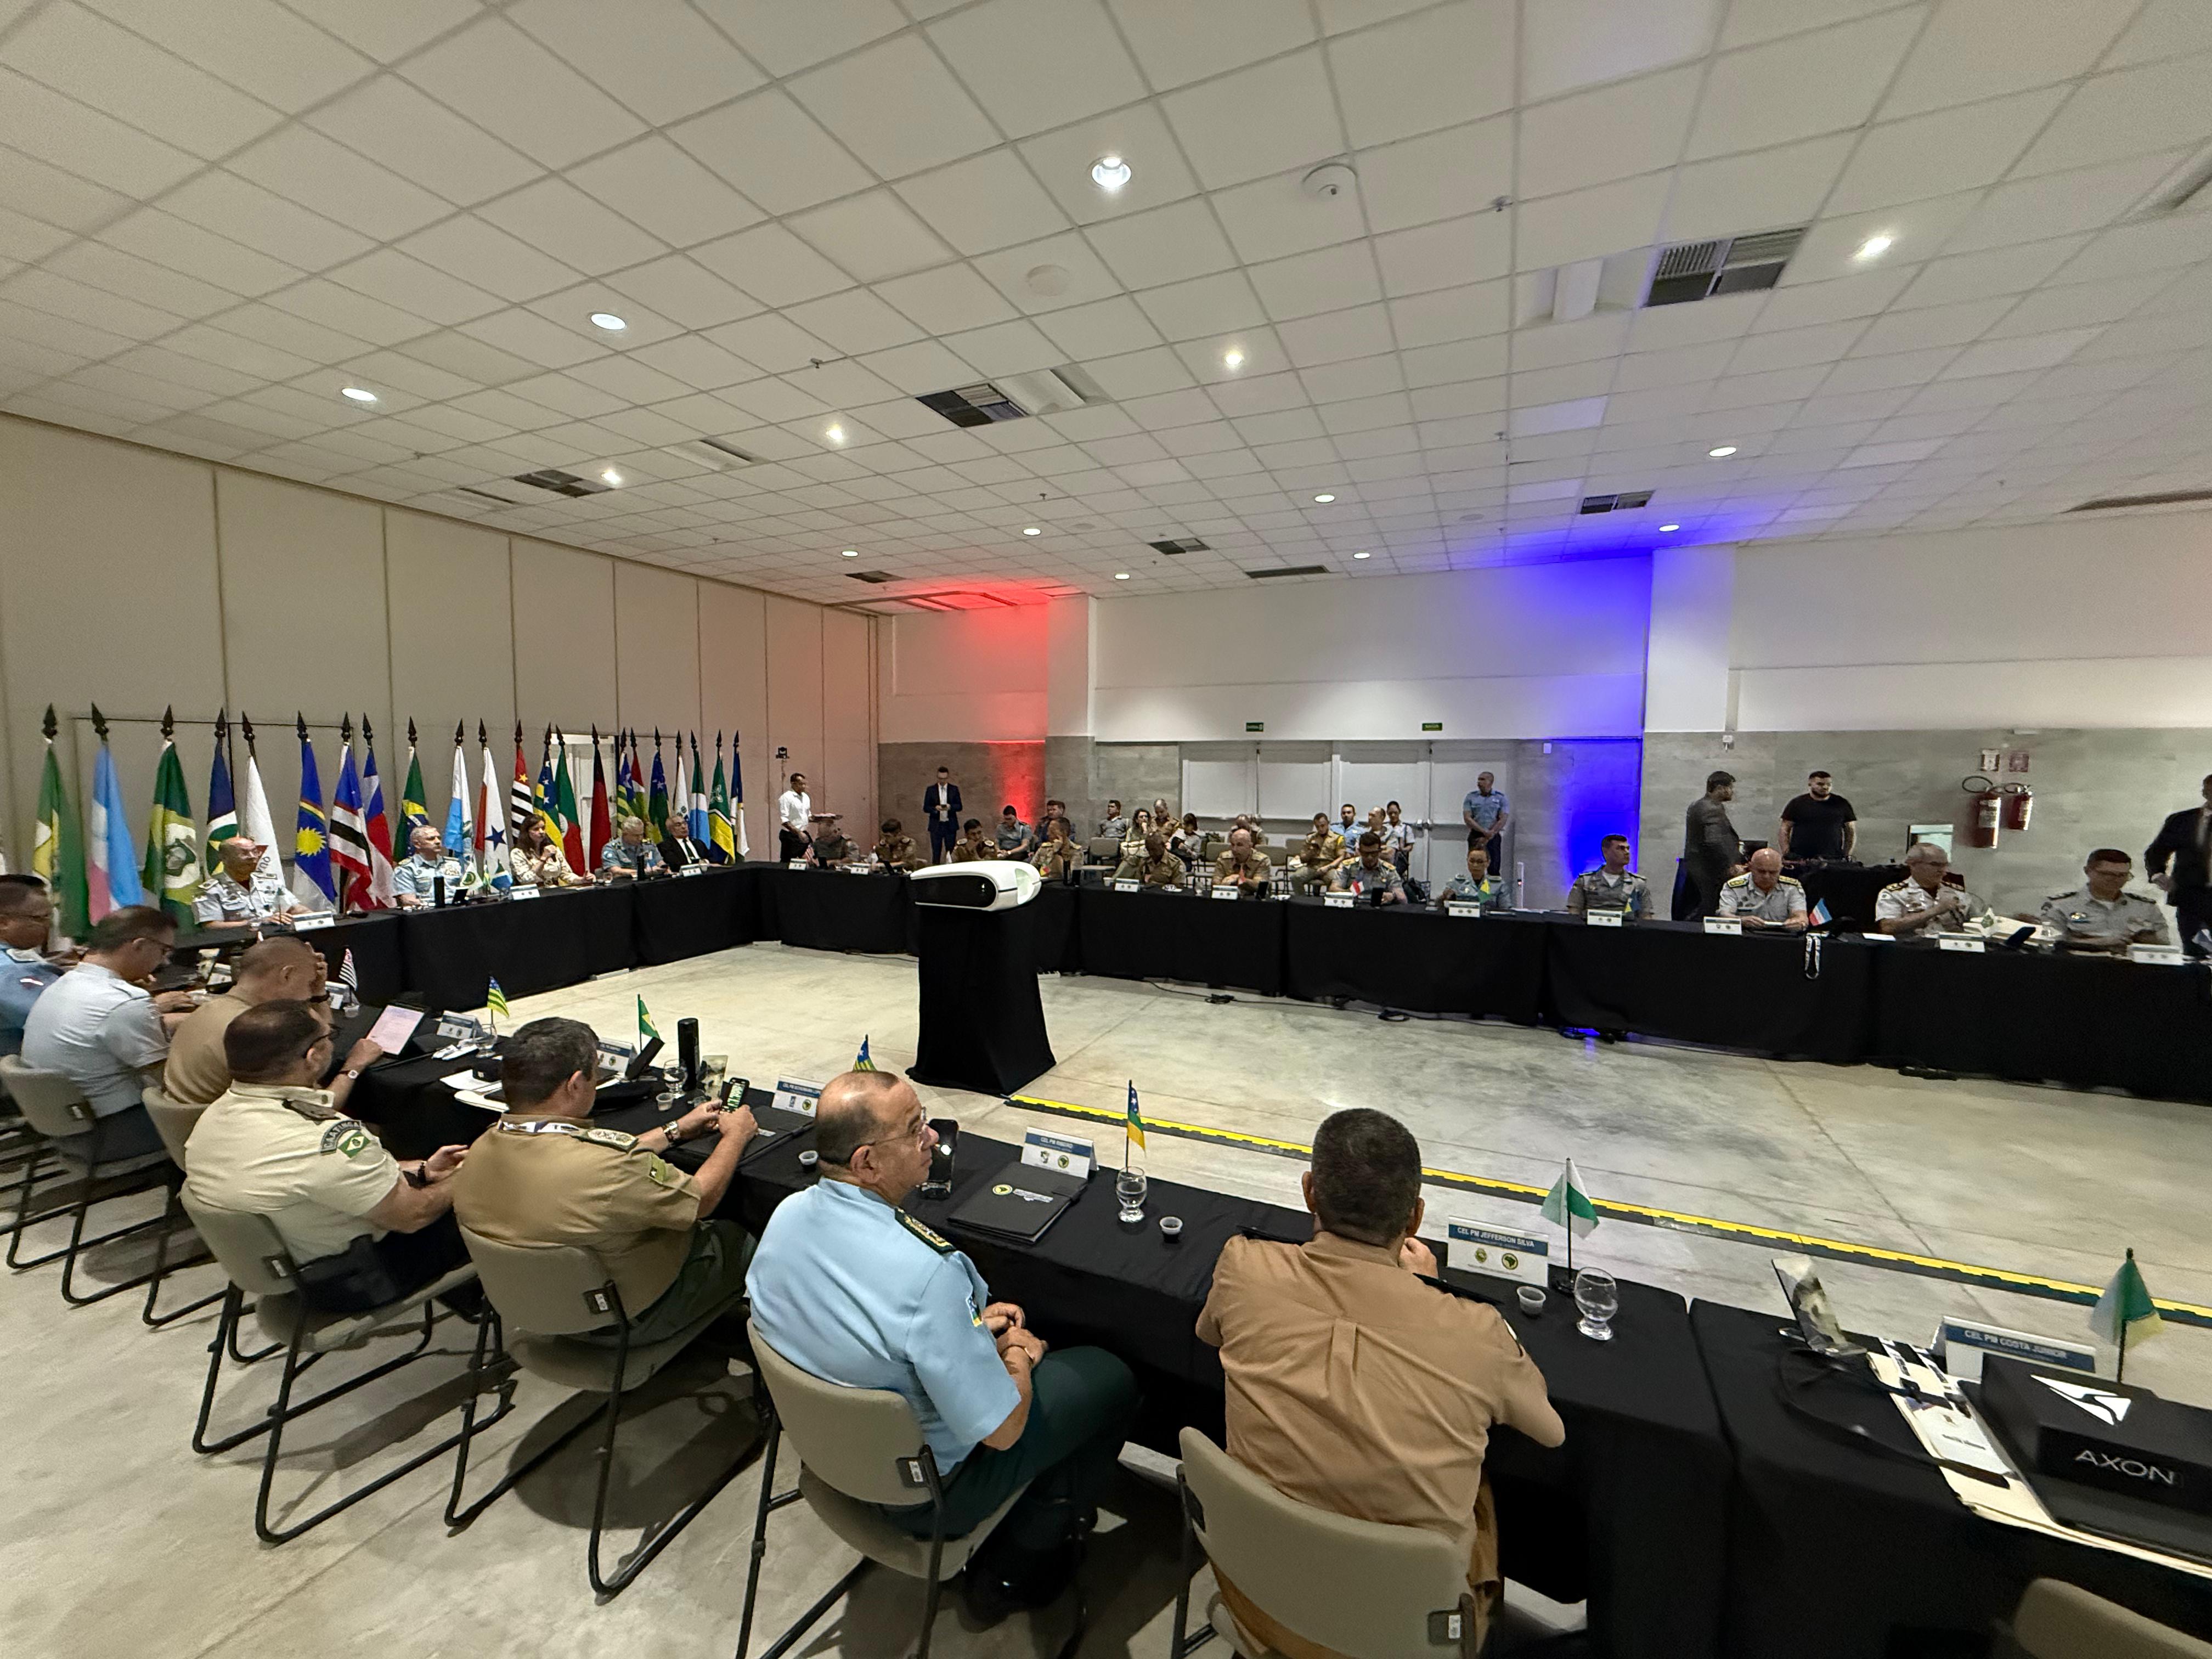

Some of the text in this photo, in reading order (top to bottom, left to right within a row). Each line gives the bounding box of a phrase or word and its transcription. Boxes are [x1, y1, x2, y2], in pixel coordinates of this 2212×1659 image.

[1457, 1227, 1469, 1235] CEL
[1481, 1232, 1516, 1244] JEFFERSON
[1517, 1238, 1534, 1247] SILVA
[1965, 1330, 1984, 1341] CEL
[1984, 1334, 1998, 1344] PM
[2000, 1338, 2030, 1350] COSTA
[2075, 1450, 2175, 1485] AXON
